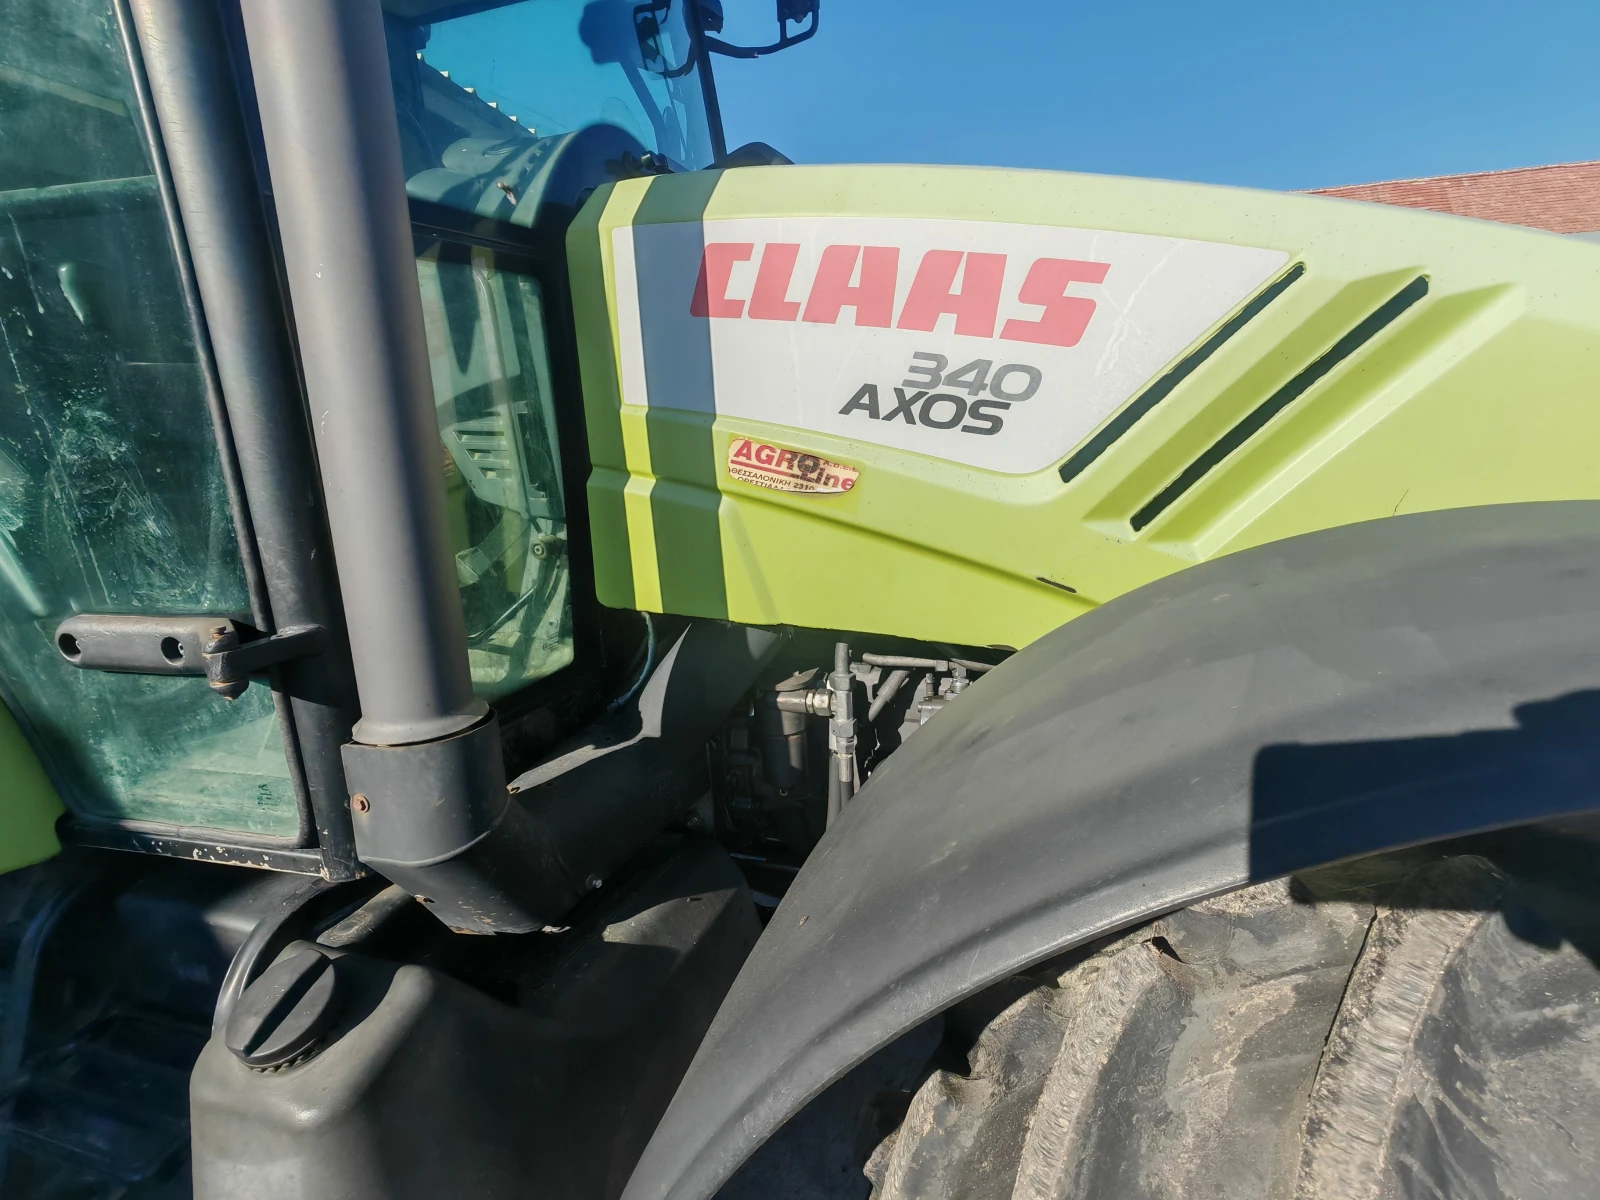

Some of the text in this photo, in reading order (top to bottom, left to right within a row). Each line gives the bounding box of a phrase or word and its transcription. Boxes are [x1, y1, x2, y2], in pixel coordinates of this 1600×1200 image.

[690, 243, 1111, 347] CLAAS
[902, 351, 1042, 402] 340
[839, 383, 1011, 436] AXOS
